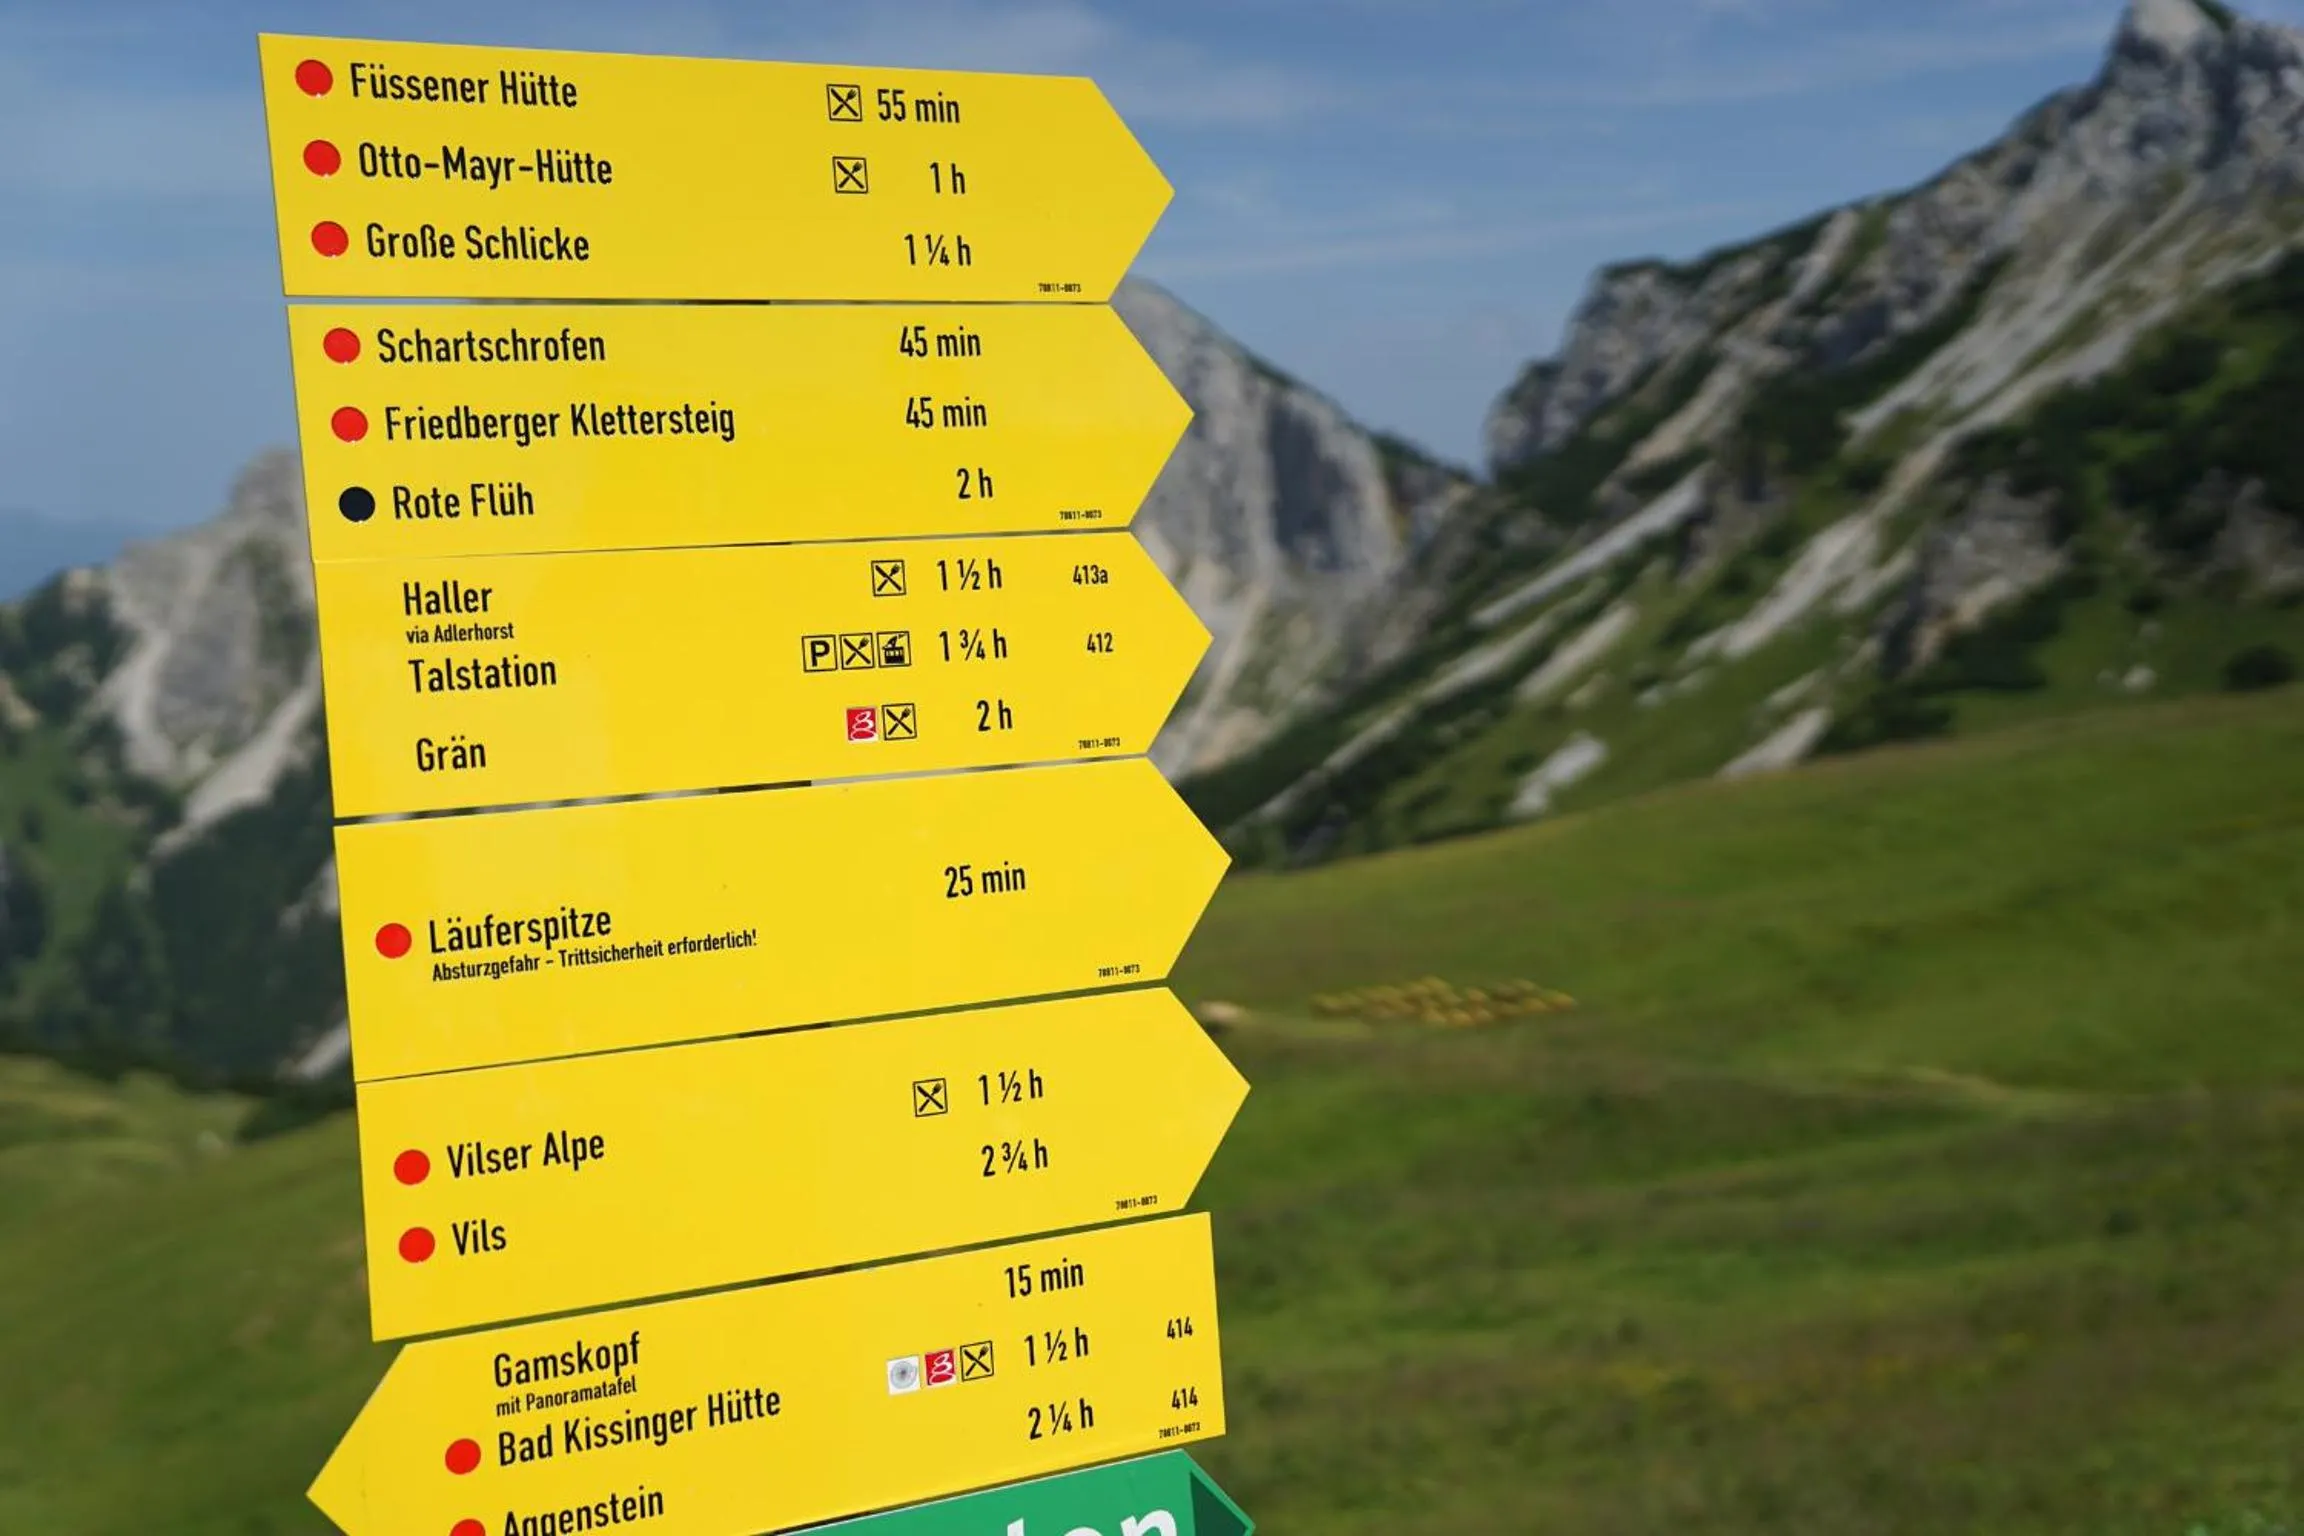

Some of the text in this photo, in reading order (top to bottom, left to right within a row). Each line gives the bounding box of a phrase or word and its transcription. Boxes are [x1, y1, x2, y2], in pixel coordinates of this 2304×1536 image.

[349, 62, 578, 109] Füssener Hütte
[876, 88, 961, 124] 55 min
[358, 141, 613, 191] Otto-Mayr-Hütte
[929, 161, 966, 195] 1 h
[366, 222, 590, 262] Große Schlicke
[904, 233, 917, 266] 1
[956, 234, 972, 267] h
[376, 327, 606, 364] Schartschrofen
[899, 325, 982, 358] 45 min
[384, 400, 736, 448] Friedberger Klettersteig
[905, 396, 988, 429] 45 min
[392, 481, 534, 520] Rote Flüh
[956, 467, 994, 500] 2 h
[936, 559, 948, 591] 1
[987, 558, 1003, 589] h
[1072, 564, 1109, 586] 413a
[403, 579, 493, 617] Haller
[405, 622, 515, 644] via Adlerhorst
[938, 630, 950, 662] 1
[992, 627, 1008, 659] h
[1086, 632, 1114, 653] 412
[407, 654, 557, 693] Talstation
[976, 699, 1013, 732] 2 h
[415, 735, 487, 773] Grän
[944, 860, 1026, 899] 25 min
[429, 906, 612, 955] Läuferspitze
[432, 953, 541, 982] Absturzgefahr
[557, 940, 665, 968] Trittsicherheit
[667, 928, 757, 956] erforderlich!
[978, 1074, 989, 1106] 1
[1028, 1068, 1044, 1099] h
[446, 1130, 605, 1179] Vilser Alpe
[981, 1144, 996, 1178] 2
[1033, 1137, 1049, 1169] h
[451, 1218, 507, 1256] Vils
[1004, 1257, 1084, 1299] 15 min
[1024, 1334, 1036, 1367] 1
[1074, 1326, 1089, 1358] h
[1166, 1316, 1193, 1340] 414
[493, 1330, 640, 1388] Gamskopf
[495, 1375, 637, 1417] mit Panoramatafel
[1171, 1386, 1199, 1410] 414
[498, 1387, 781, 1467] Bad Kissinger Hütte
[1027, 1406, 1043, 1441] 2
[1079, 1397, 1094, 1429] h
